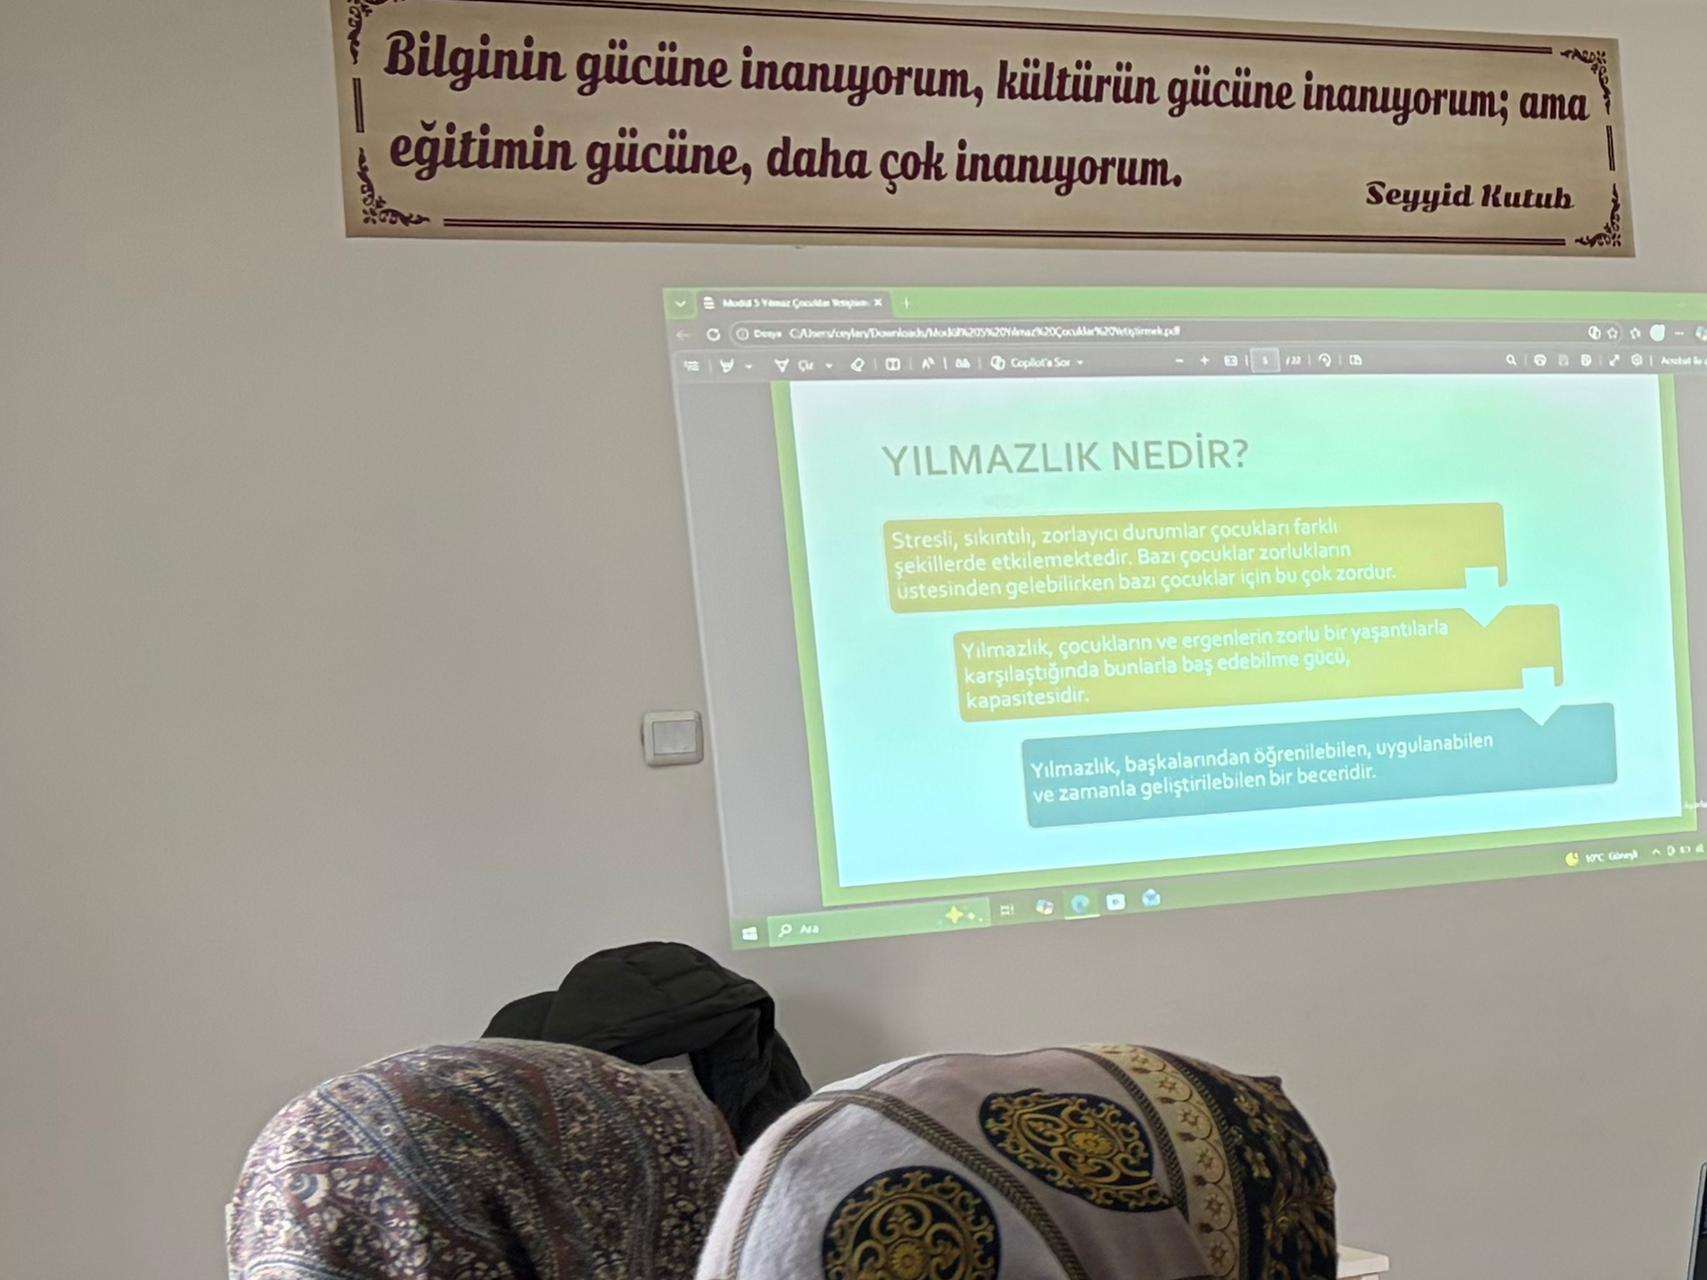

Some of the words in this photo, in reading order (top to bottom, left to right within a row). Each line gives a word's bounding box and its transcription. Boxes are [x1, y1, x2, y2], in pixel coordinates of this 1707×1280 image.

[384, 29, 567, 93] Bilginin
[577, 39, 732, 97] gücüne
[741, 45, 984, 108] inanıyorum,
[997, 57, 1161, 105] kültürün
[1168, 68, 1295, 118] gücüne
[1303, 71, 1510, 126] inanıyorum;
[1519, 92, 1591, 122] ama
[390, 117, 576, 182] eğitimin
[586, 127, 752, 186] gücüne,
[767, 136, 871, 181] daha
[880, 139, 947, 195] çok
[956, 139, 1183, 196] inanıyorum.
[1366, 181, 1475, 214] Seyyid
[1480, 183, 1574, 211] Kutub
[881, 441, 1102, 477] YILMAZLIK
[1113, 431, 1249, 471] NEDİR?
[892, 530, 959, 553] Stresli,
[964, 528, 1036, 548] sıkıntılı,
[1042, 526, 1119, 547] zorlayıcı
[1123, 522, 1206, 542] durumlar
[1211, 519, 1289, 542] çocukları
[1294, 517, 1338, 537] farklı
[893, 554, 986, 578] şekillerde
[992, 549, 1133, 572] etkilemektedir.
[1138, 547, 1175, 566] Bazı
[1180, 543, 1255, 566] çocuklar
[1260, 539, 1351, 562] zorlukların
[897, 578, 1001, 601] üstesinden
[1007, 573, 1113, 598] gelebilirken
[1119, 569, 1156, 590] bazı
[1161, 567, 1234, 591] çocuklar
[1242, 567, 1271, 588] için
[1276, 566, 1297, 584] bu
[1301, 565, 1331, 587] çok
[1336, 562, 1396, 582] zordur.
[961, 637, 1053, 661] Yılmazlık,
[1059, 634, 1151, 657] çocukların
[1157, 636, 1177, 651] ve
[1183, 629, 1271, 653] ergenlerin
[1276, 623, 1320, 644] zorlu
[1324, 622, 1348, 642] bir
[1351, 619, 1449, 644] yaşantılarla
[964, 660, 1100, 688] karşılaştığında
[1104, 656, 1177, 678] bunlarla
[1182, 654, 1214, 677] baş
[1217, 648, 1300, 671] edebilme
[1304, 648, 1351, 670] gücü,
[966, 685, 1090, 713] kapasitesidir.
[1031, 756, 1121, 782] Yılmazlık,
[1124, 750, 1250, 776] başkalarından
[1254, 738, 1373, 768] öğrenilebilen,
[1376, 732, 1493, 759] uygulanabilen
[1033, 787, 1054, 804] ve
[1058, 780, 1136, 802] zamanla
[1140, 772, 1265, 801] geliştirilebilen
[1269, 767, 1293, 787] bir
[1297, 764, 1377, 786] beceridir.
[799, 923, 820, 935] Ara
